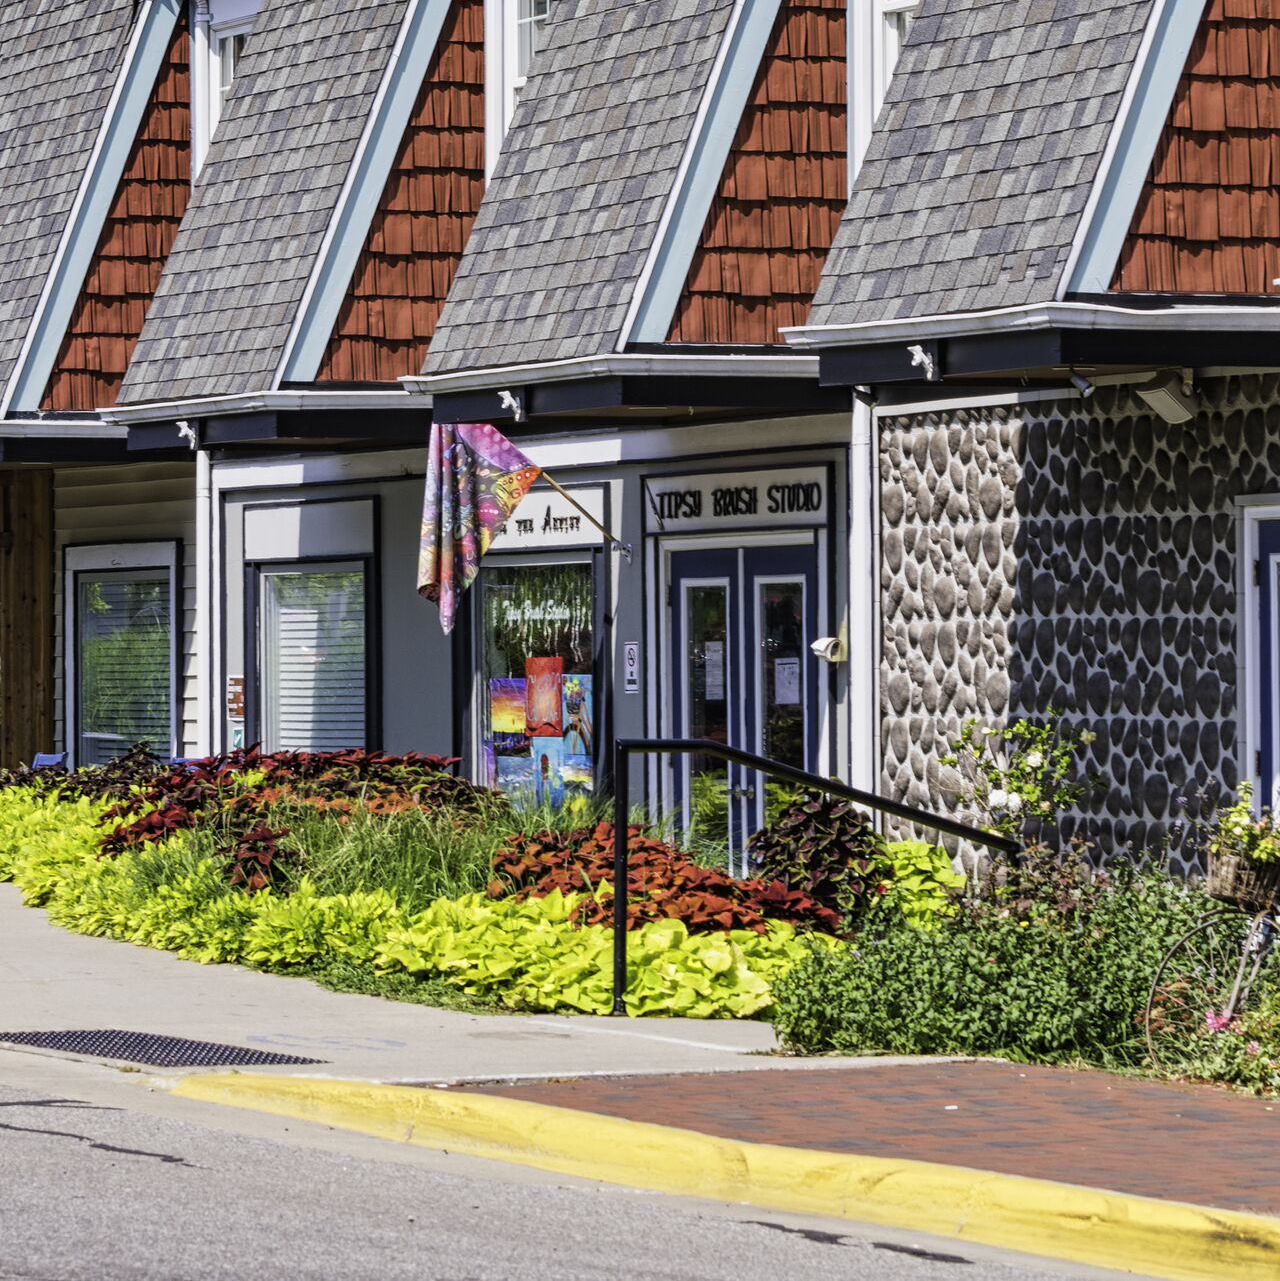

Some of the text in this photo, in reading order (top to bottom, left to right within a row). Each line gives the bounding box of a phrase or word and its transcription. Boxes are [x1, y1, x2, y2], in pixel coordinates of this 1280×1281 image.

[656, 481, 822, 519] TIPSY BRUSH STUDIO
